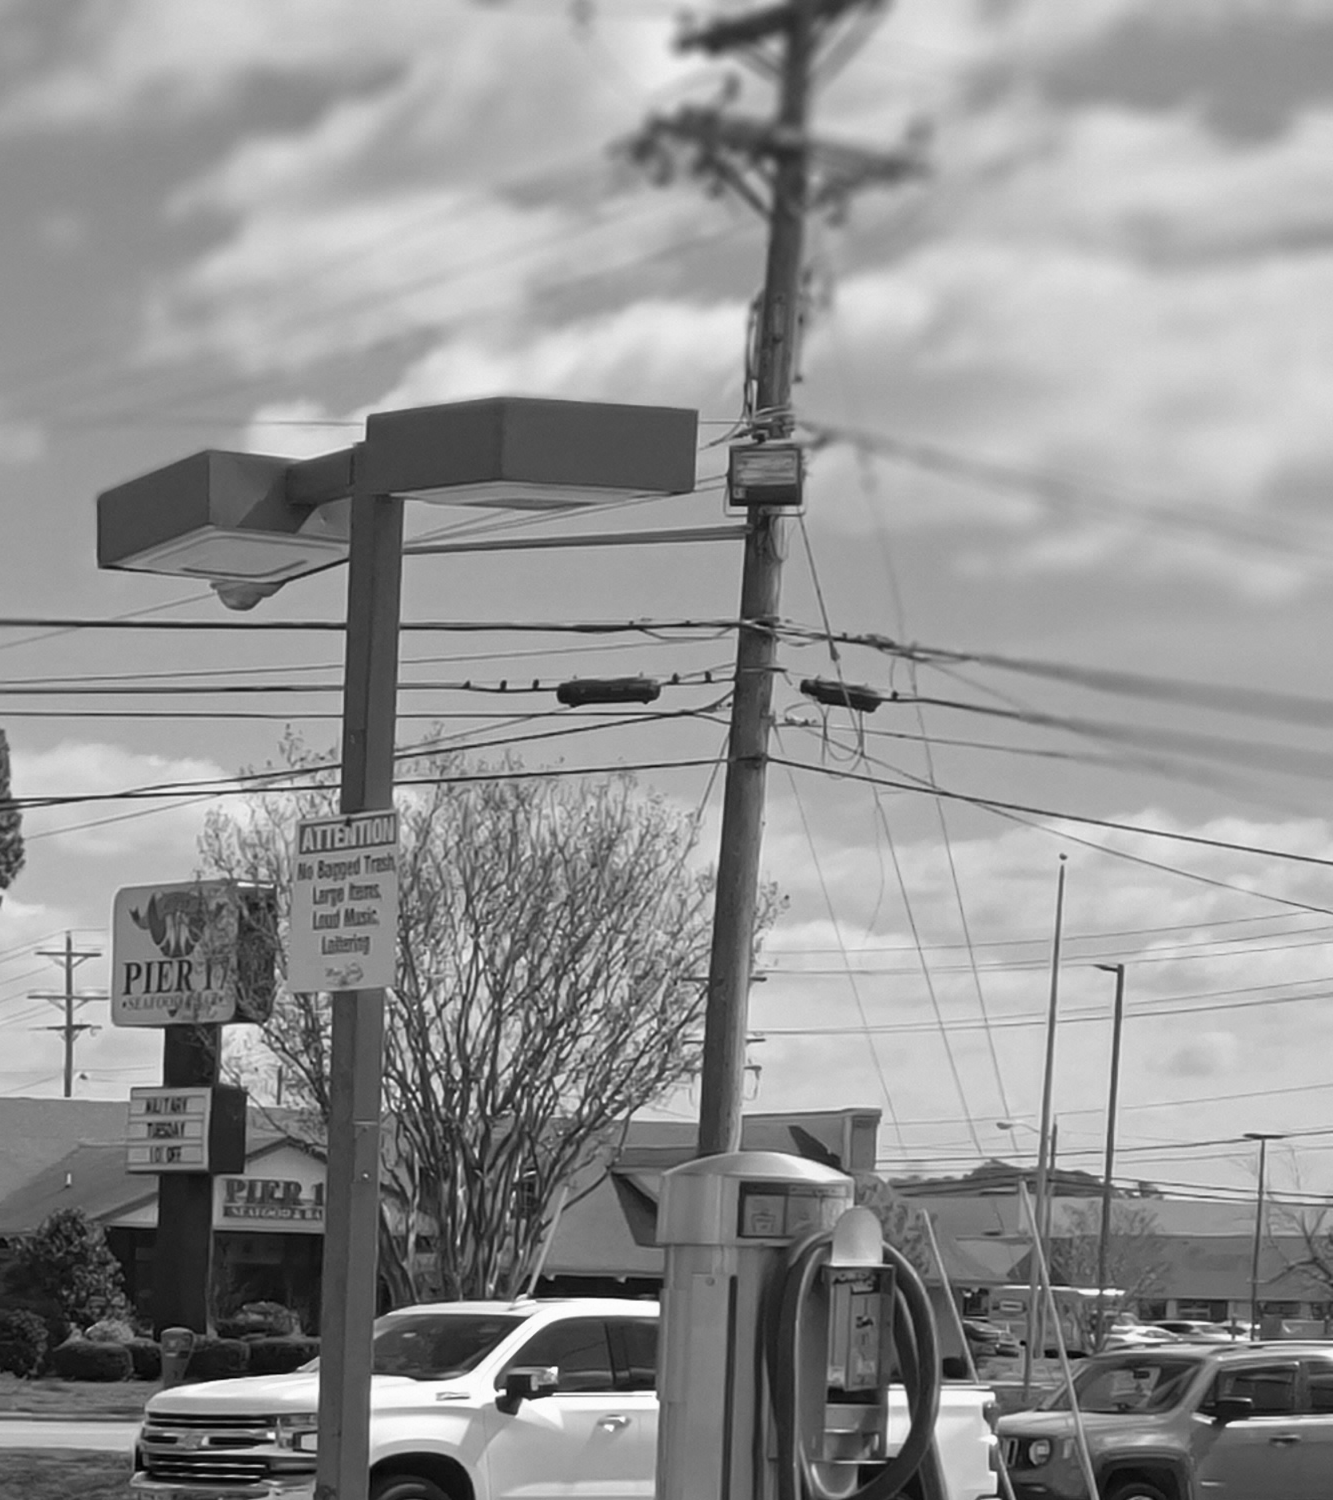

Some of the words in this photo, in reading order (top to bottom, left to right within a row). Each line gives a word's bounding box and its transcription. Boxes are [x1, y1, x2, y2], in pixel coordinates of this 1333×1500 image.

[301, 816, 396, 852] ATTENTION
[297, 862, 314, 881] No
[317, 856, 361, 882] Bagged
[312, 885, 345, 908] Large
[313, 910, 340, 930] Loud
[321, 933, 371, 956] Loitering
[122, 958, 194, 996] PIER
[224, 1178, 303, 1206] PIER
